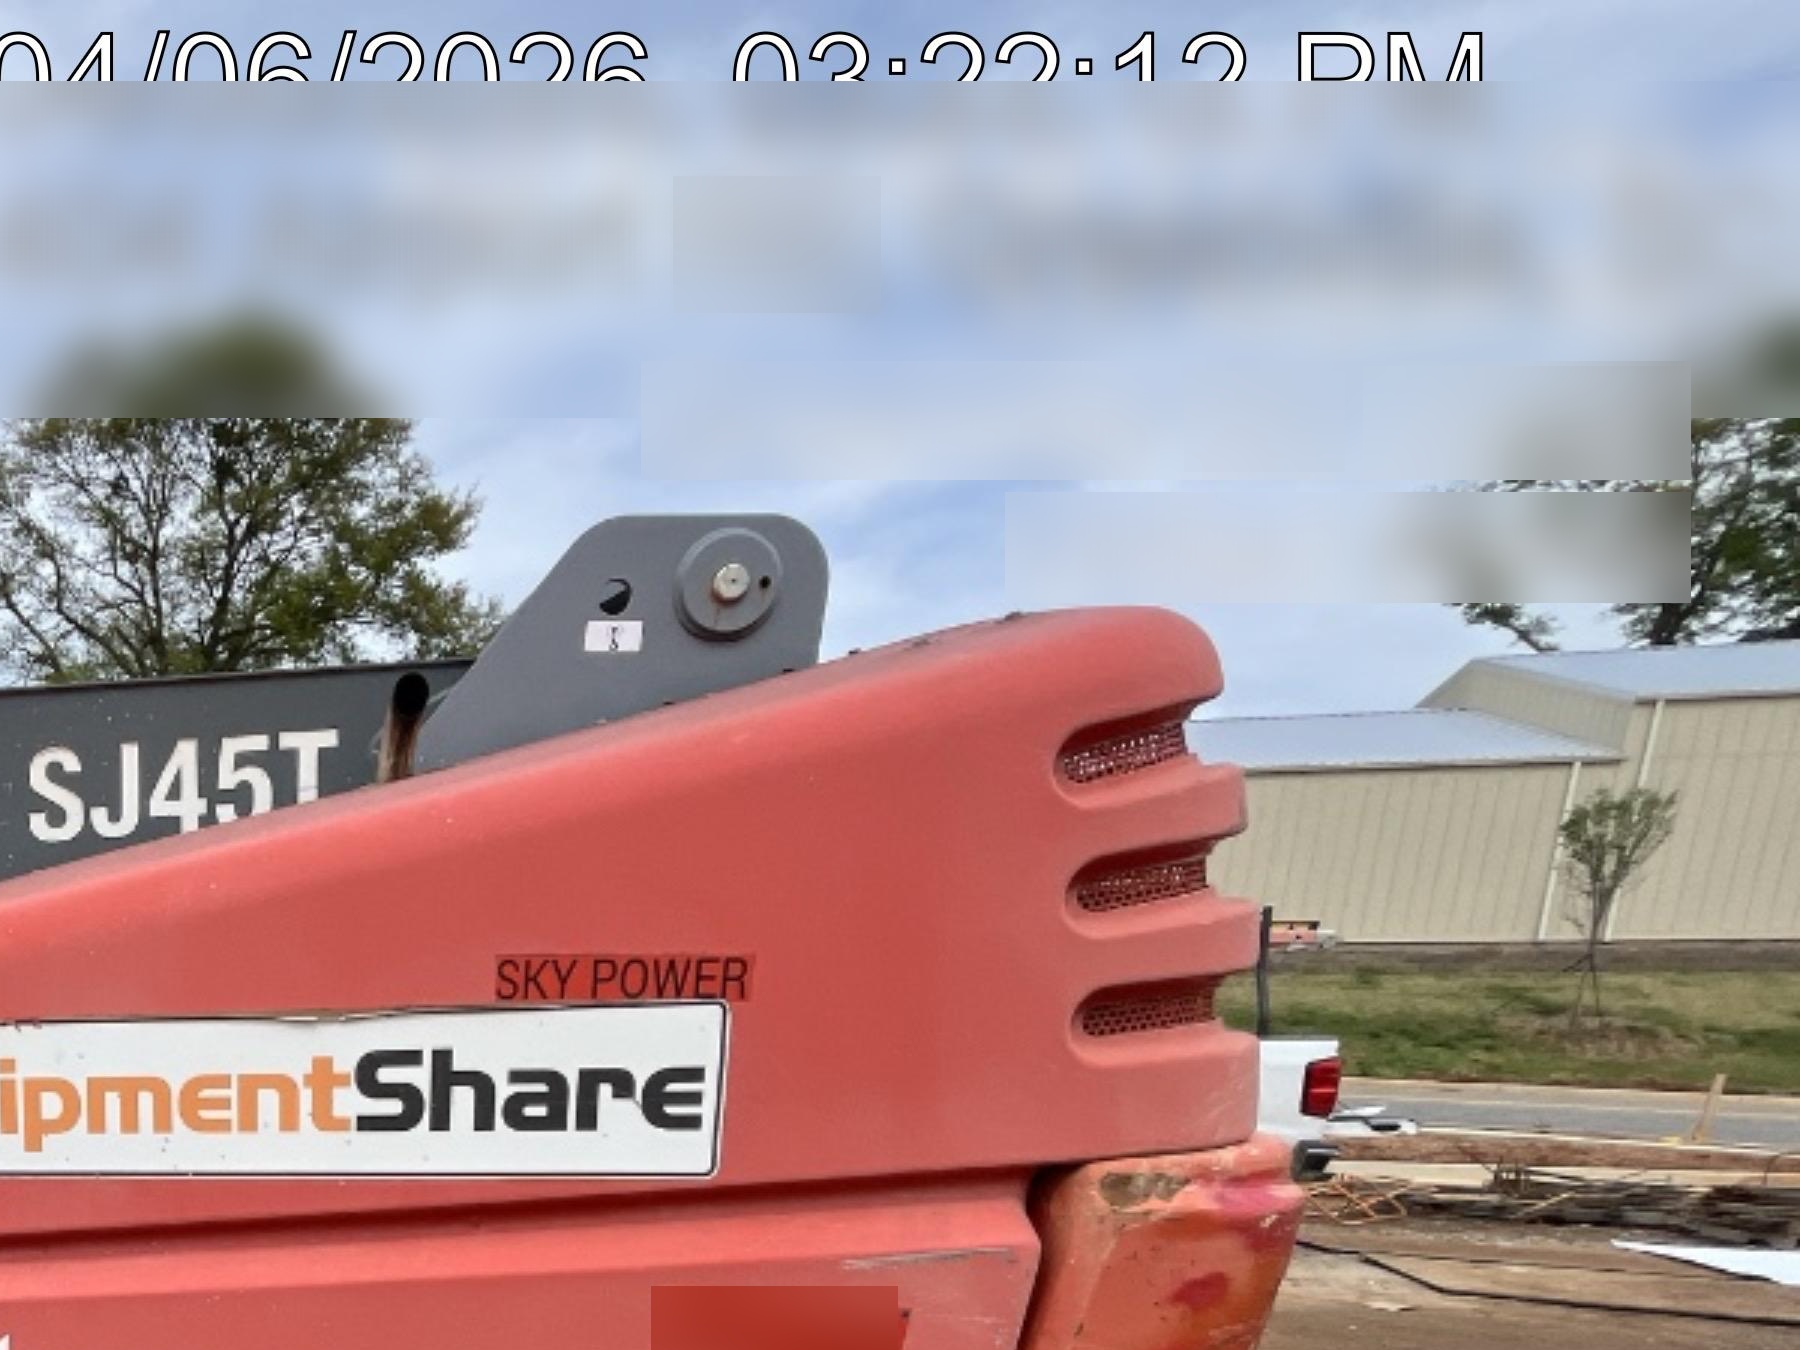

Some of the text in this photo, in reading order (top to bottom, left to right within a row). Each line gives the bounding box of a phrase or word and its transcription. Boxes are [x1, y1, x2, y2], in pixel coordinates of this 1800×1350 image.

[27, 728, 341, 843] SJ45T
[496, 957, 748, 1001] SKY POWER
